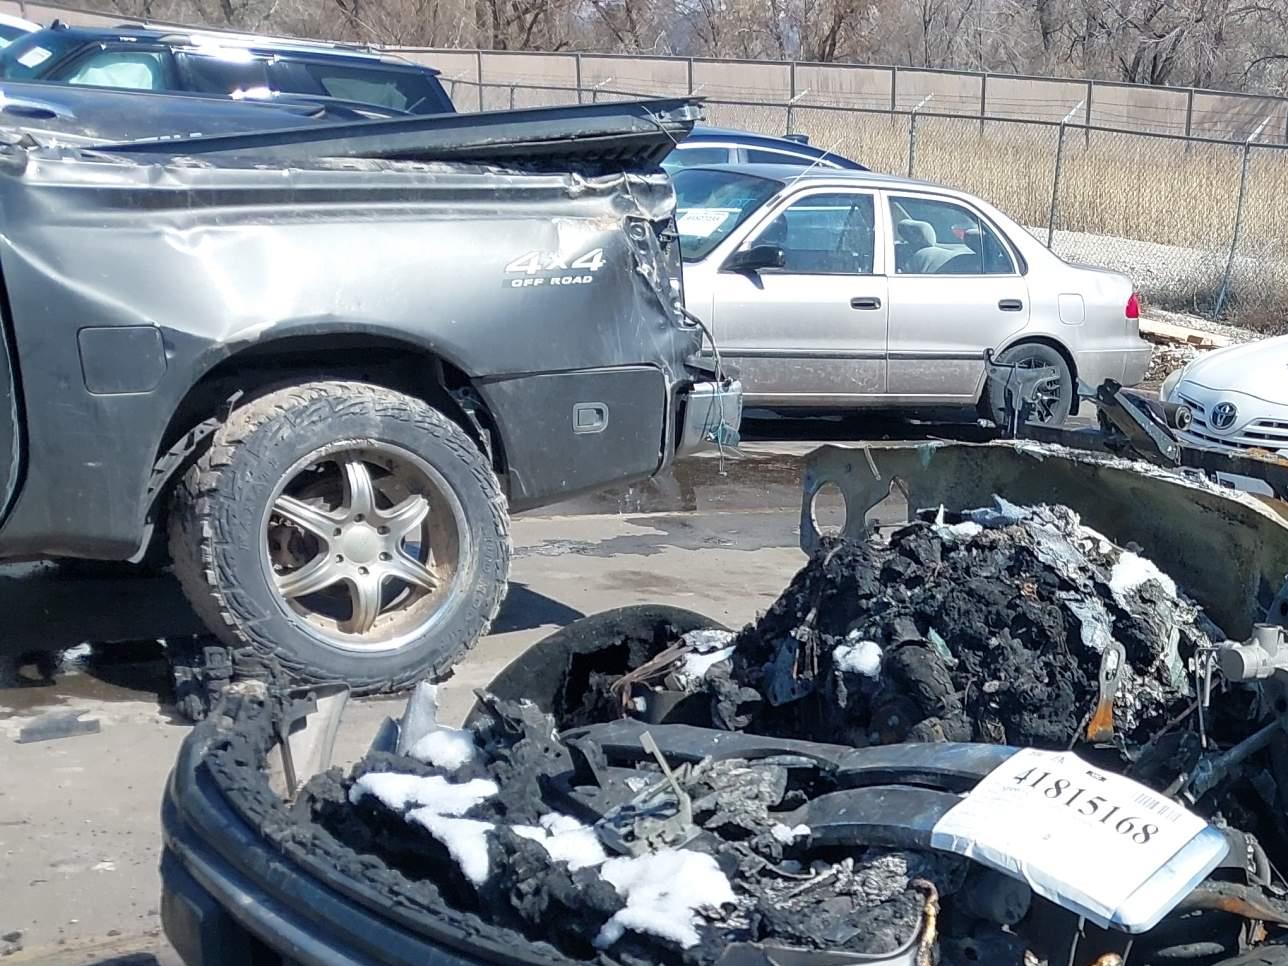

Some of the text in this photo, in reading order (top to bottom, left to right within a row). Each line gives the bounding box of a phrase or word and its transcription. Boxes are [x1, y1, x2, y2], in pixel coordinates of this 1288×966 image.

[511, 275, 593, 288] OFF ROAD
[1012, 767, 1160, 845] 41815168
